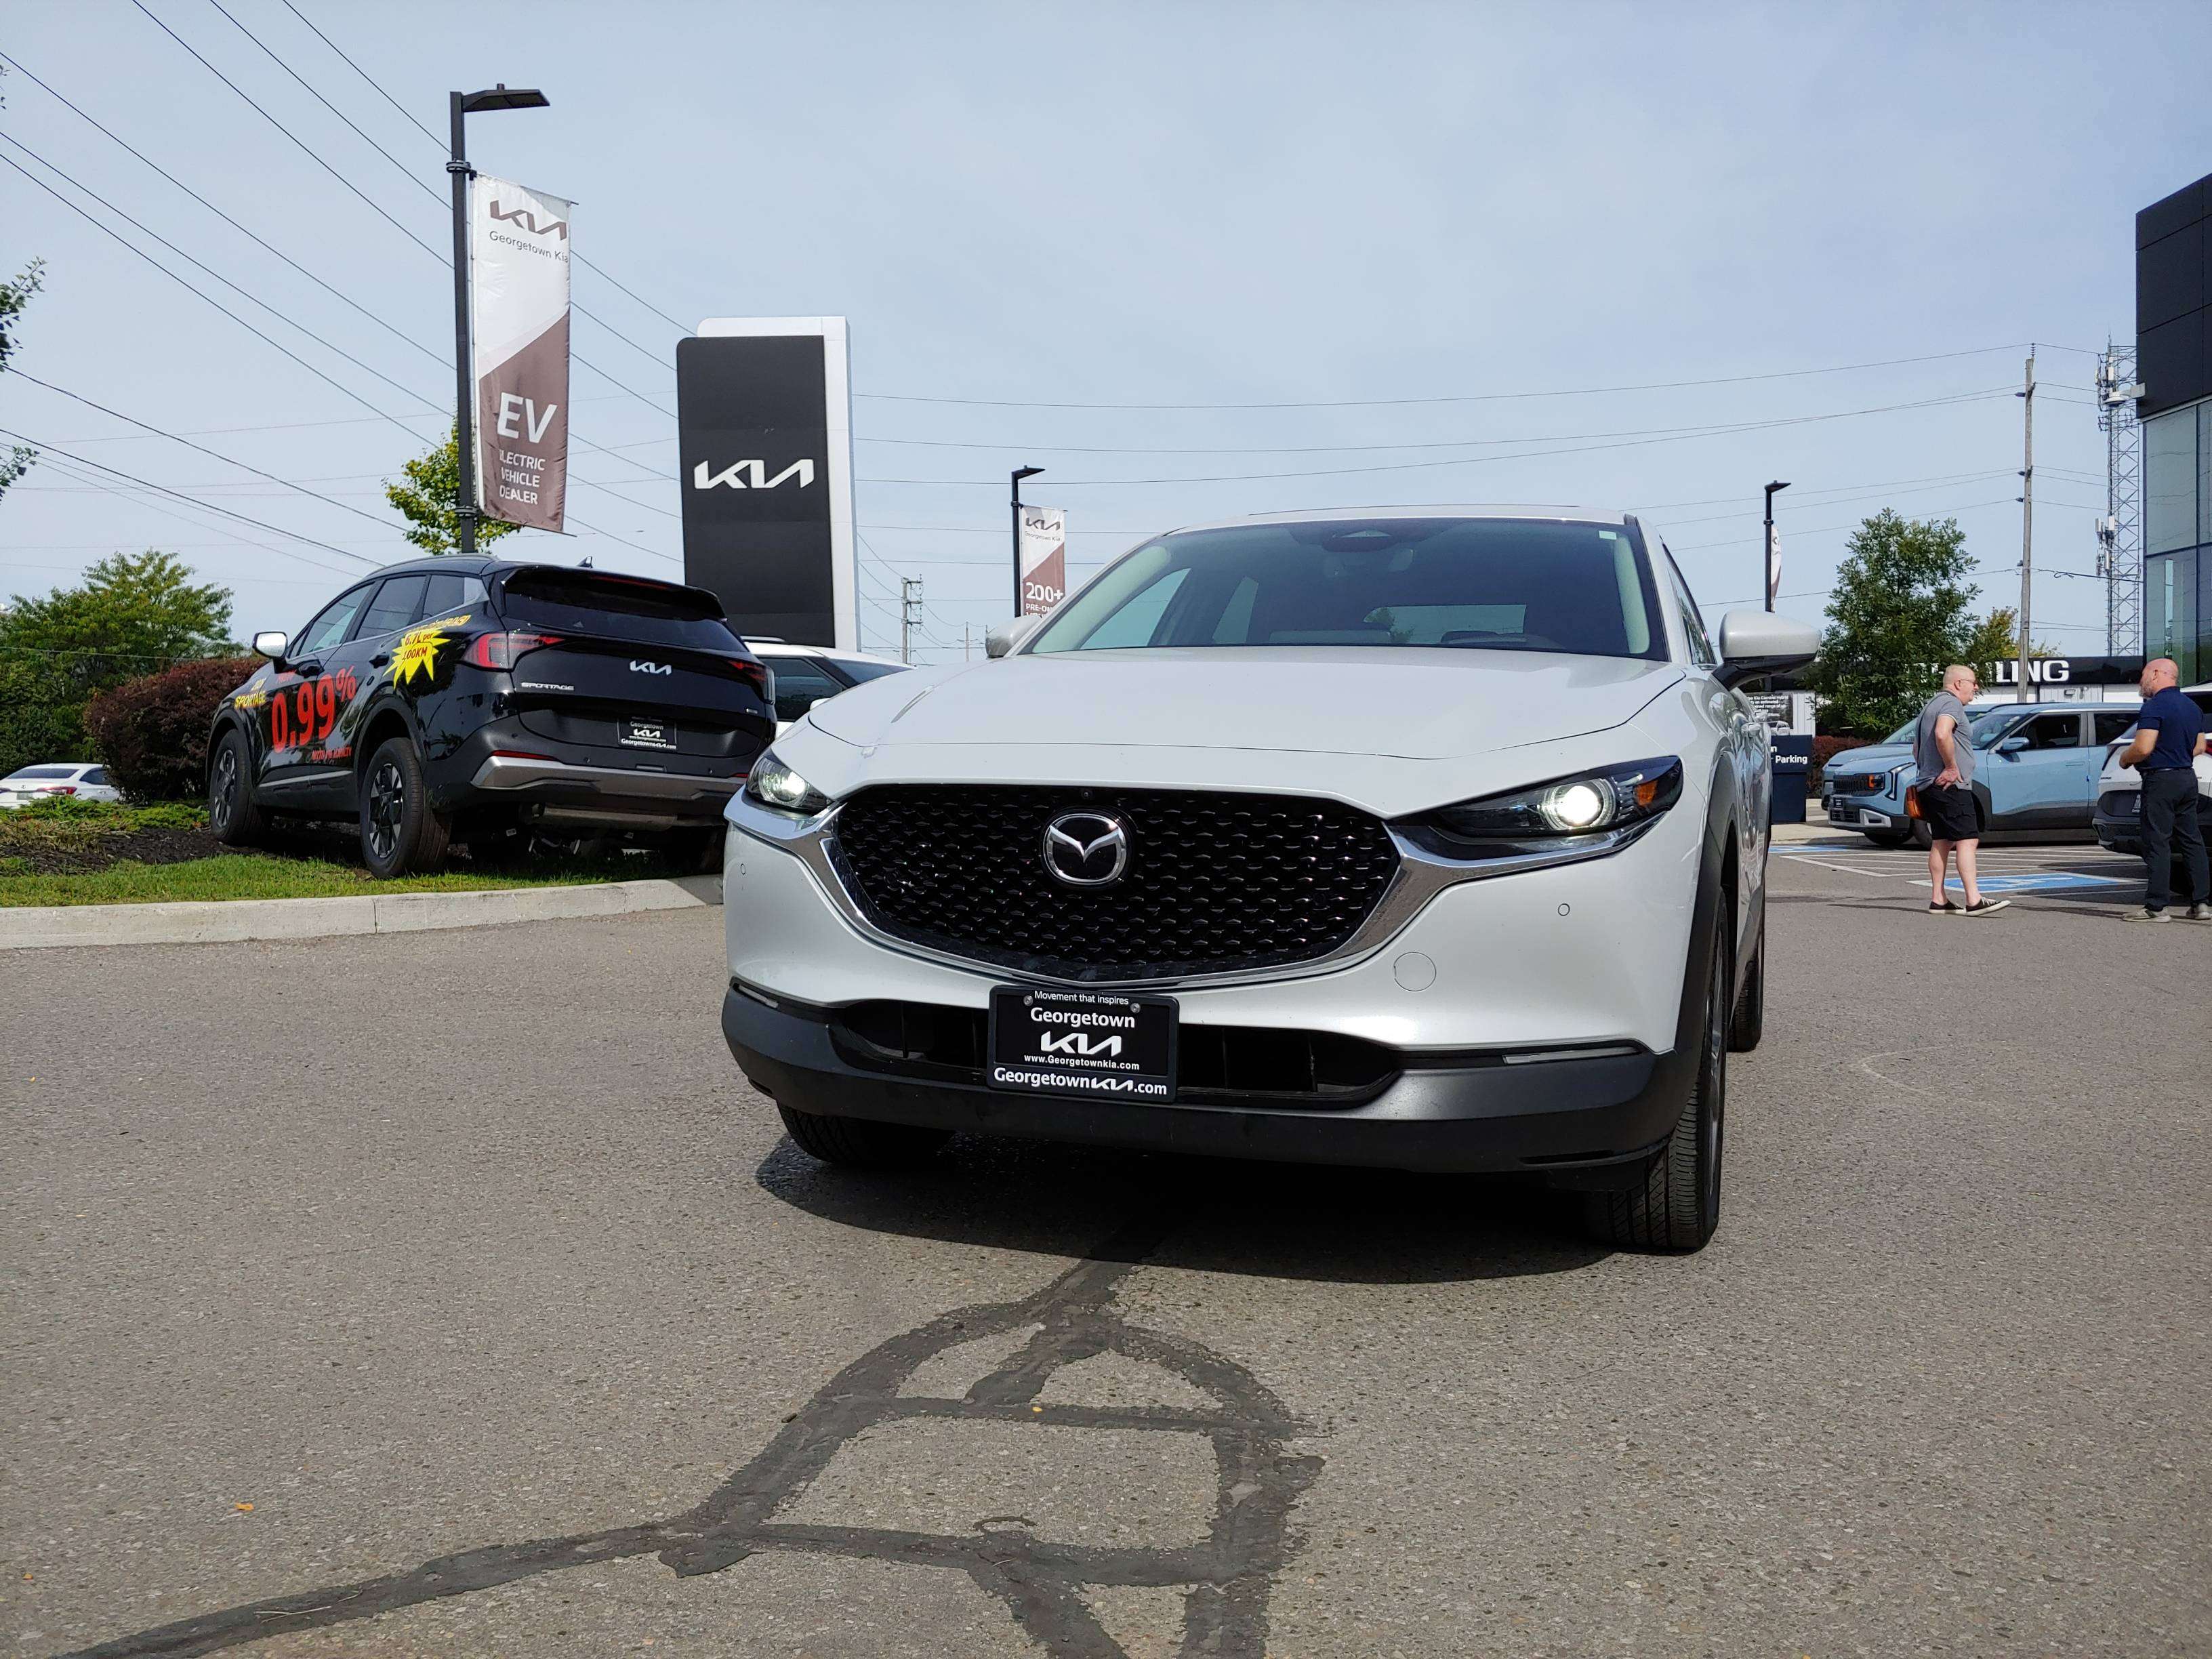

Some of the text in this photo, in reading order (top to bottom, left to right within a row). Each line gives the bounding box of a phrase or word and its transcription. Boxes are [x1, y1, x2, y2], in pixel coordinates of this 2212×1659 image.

[490, 200, 567, 241] KIA
[489, 230, 569, 264] Georgetown Kia
[497, 392, 558, 444] EV
[499, 449, 546, 470] ELECTRIC
[501, 466, 540, 488] VEHICLE
[694, 459, 814, 489] KIA
[499, 485, 538, 505] DEALER
[1025, 517, 1061, 531] KIA
[1025, 582, 1063, 602] 200+
[630, 660, 672, 676] KIA
[521, 682, 575, 691] SPORTAGE
[234, 691, 266, 709] SPORTAGE
[630, 721, 663, 730] Georgetown
[634, 729, 661, 739] KIA
[1776, 754, 1808, 765] Parking
[1034, 990, 1129, 1006] Movement that inspires
[1030, 1007, 1135, 1028] Georgetown
[1041, 1031, 1122, 1057] KIA
[1024, 1054, 1140, 1071] www.Georgetownkia.com
